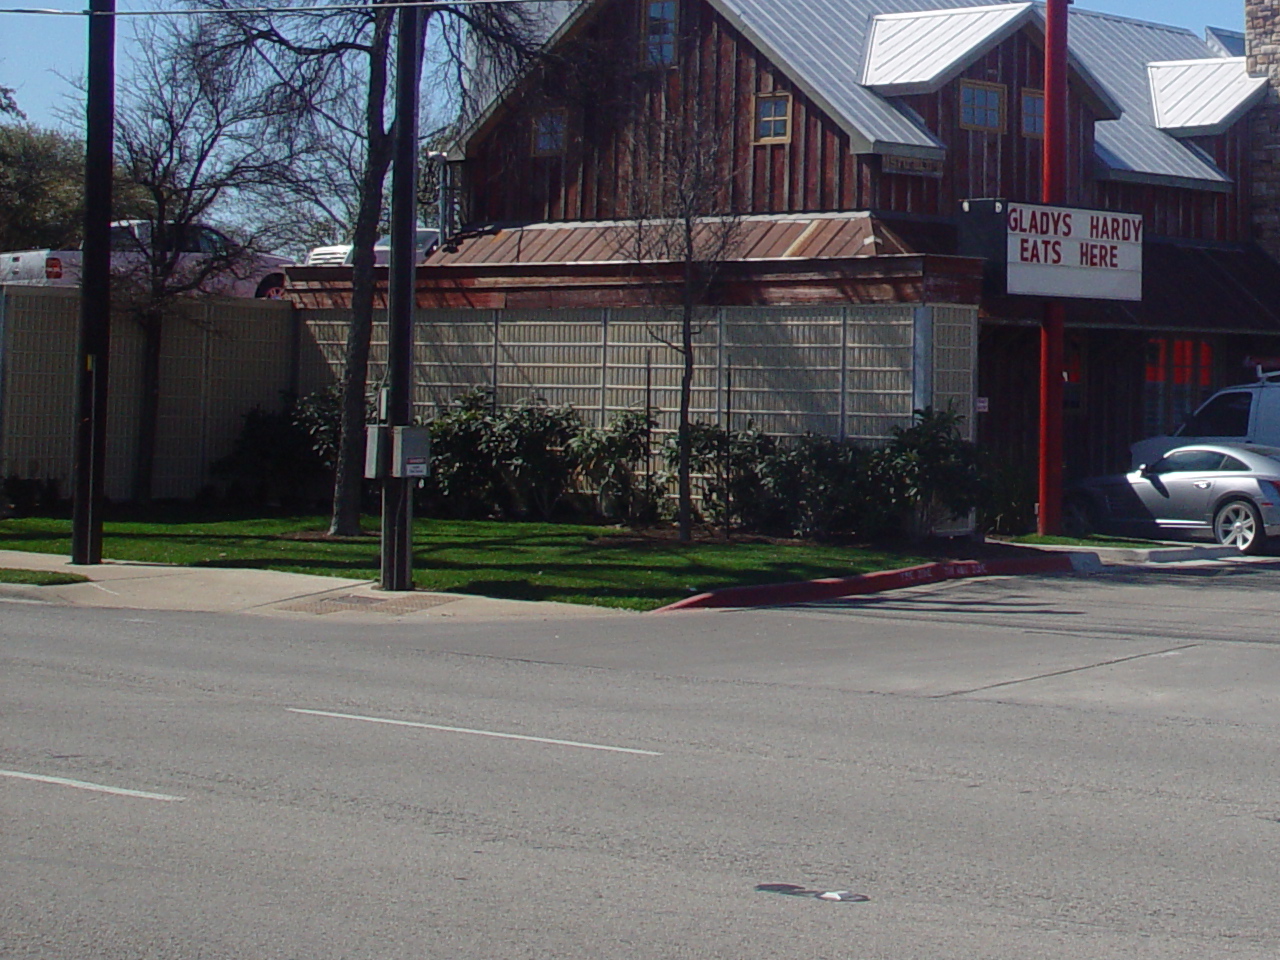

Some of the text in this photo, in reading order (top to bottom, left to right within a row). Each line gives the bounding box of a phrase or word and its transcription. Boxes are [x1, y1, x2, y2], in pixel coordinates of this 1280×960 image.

[1007, 208, 1142, 242] GLADYS HARDY
[1020, 238, 1119, 268] EATS HERE
